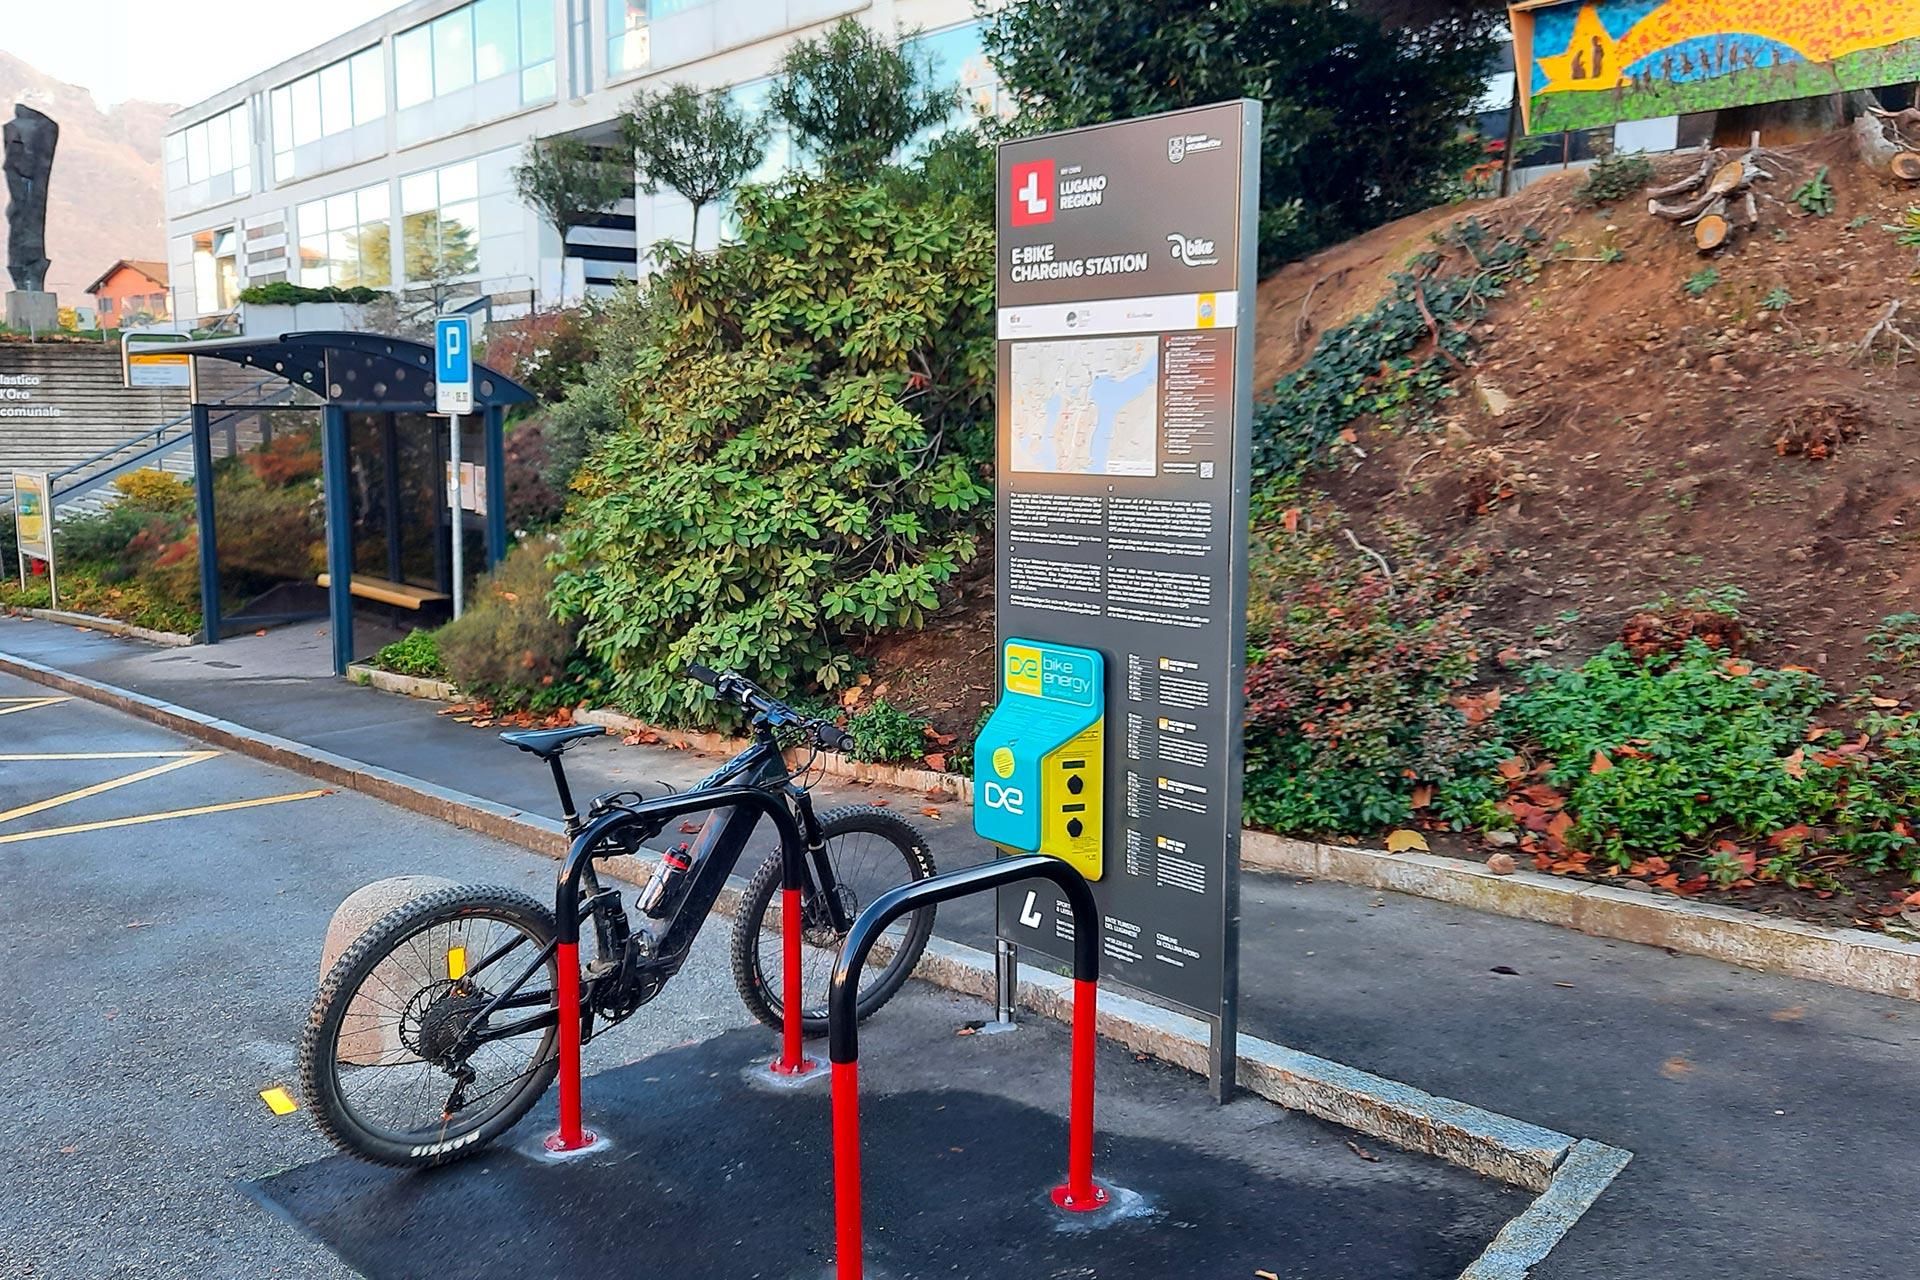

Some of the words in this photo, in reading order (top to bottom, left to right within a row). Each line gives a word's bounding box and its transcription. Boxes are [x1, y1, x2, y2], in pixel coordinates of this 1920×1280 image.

[1060, 175, 1107, 195] LUGANO
[1060, 190, 1103, 209] REGION
[1011, 244, 1055, 265] E-BIKE
[1011, 260, 1084, 283] CHARGING
[1085, 252, 1149, 276] STATION
[446, 326, 460, 369] P
[0, 406, 61, 417] comunale
[1043, 657, 1073, 674] bike
[1043, 672, 1091, 693] energy
